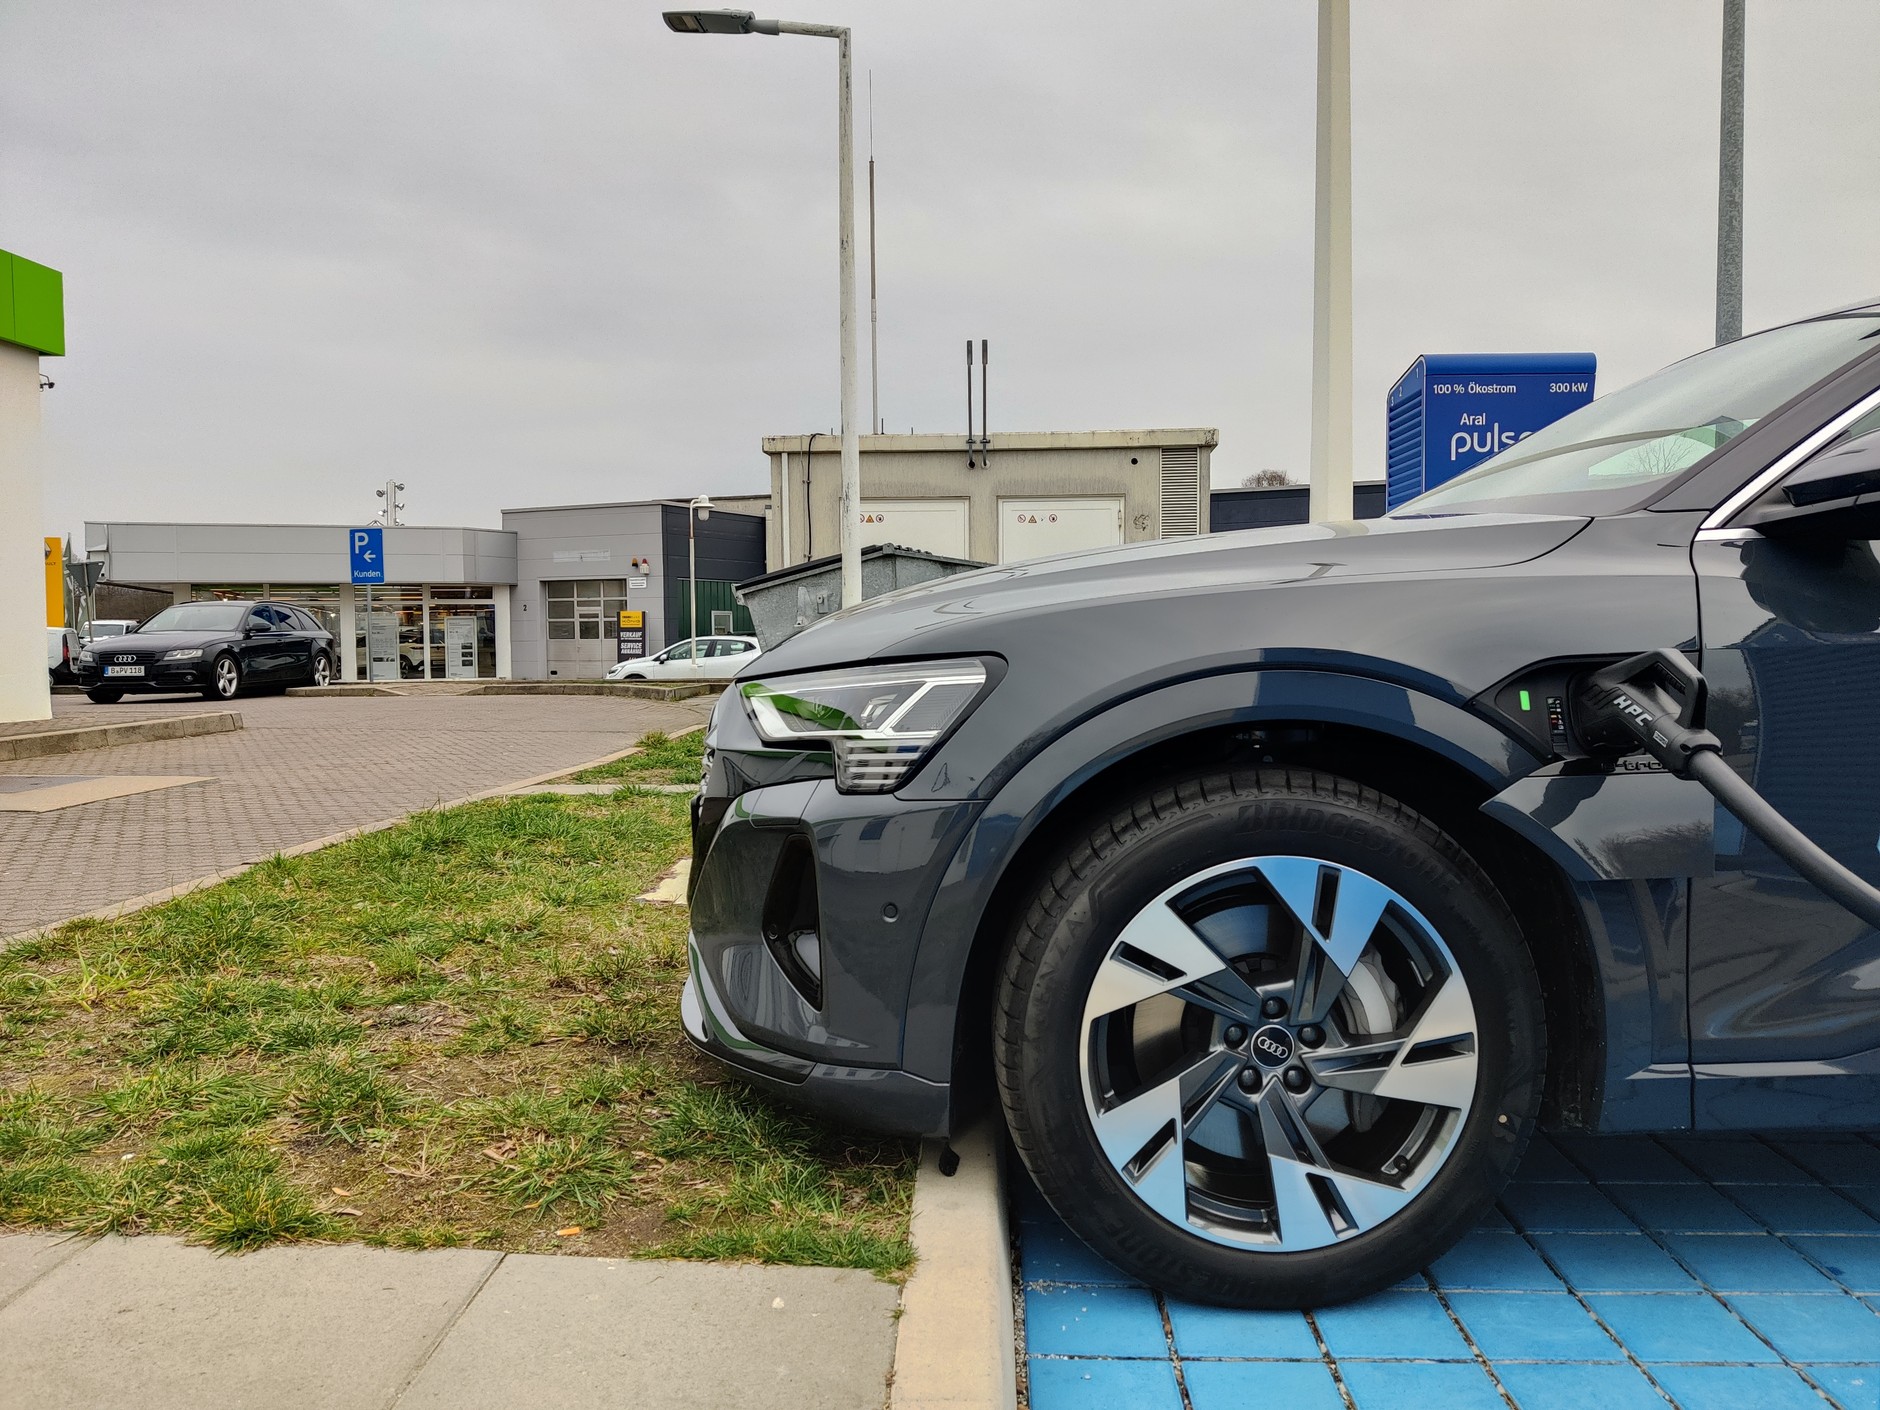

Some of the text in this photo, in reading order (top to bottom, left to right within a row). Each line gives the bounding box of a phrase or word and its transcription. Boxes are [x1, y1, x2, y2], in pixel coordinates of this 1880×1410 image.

[1398, 386, 1403, 397] 2
[1433, 382, 1517, 394] 100 % Ökostrom
[1549, 382, 1588, 393] 300 kW
[1459, 413, 1486, 426] Aral
[354, 532, 369, 554] P
[353, 569, 381, 578] Kunden
[522, 604, 528, 612] 2
[1613, 694, 1654, 727] HPC
[1600, 760, 1664, 773] e-tro
[1235, 803, 1461, 890] BRIDGESTONE
